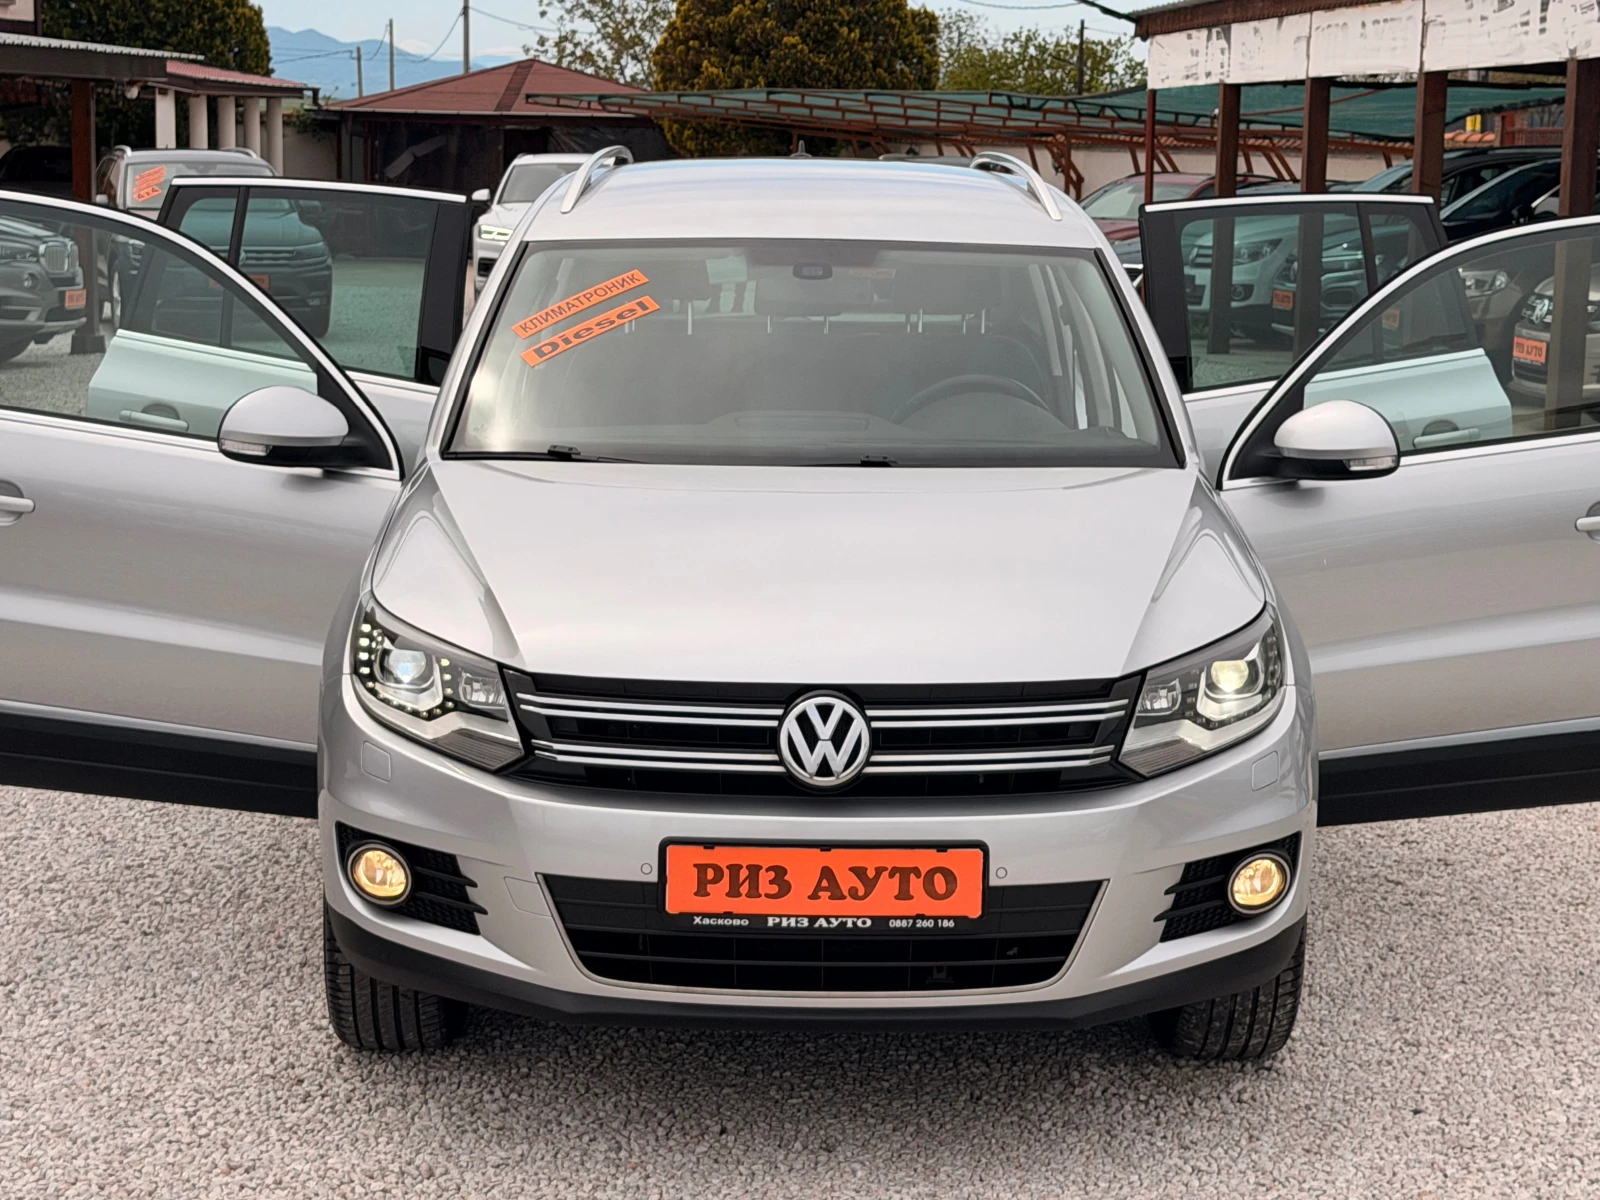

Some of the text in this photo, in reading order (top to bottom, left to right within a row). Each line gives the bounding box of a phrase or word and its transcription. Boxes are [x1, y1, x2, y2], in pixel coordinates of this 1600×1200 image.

[519, 273, 641, 333] КЛИМАТРОНИК
[532, 301, 650, 359] Diesel
[693, 863, 958, 901] РИЗ АУТО
[693, 915, 955, 929] Хасково РИЗ АУТО 0887 260 186
